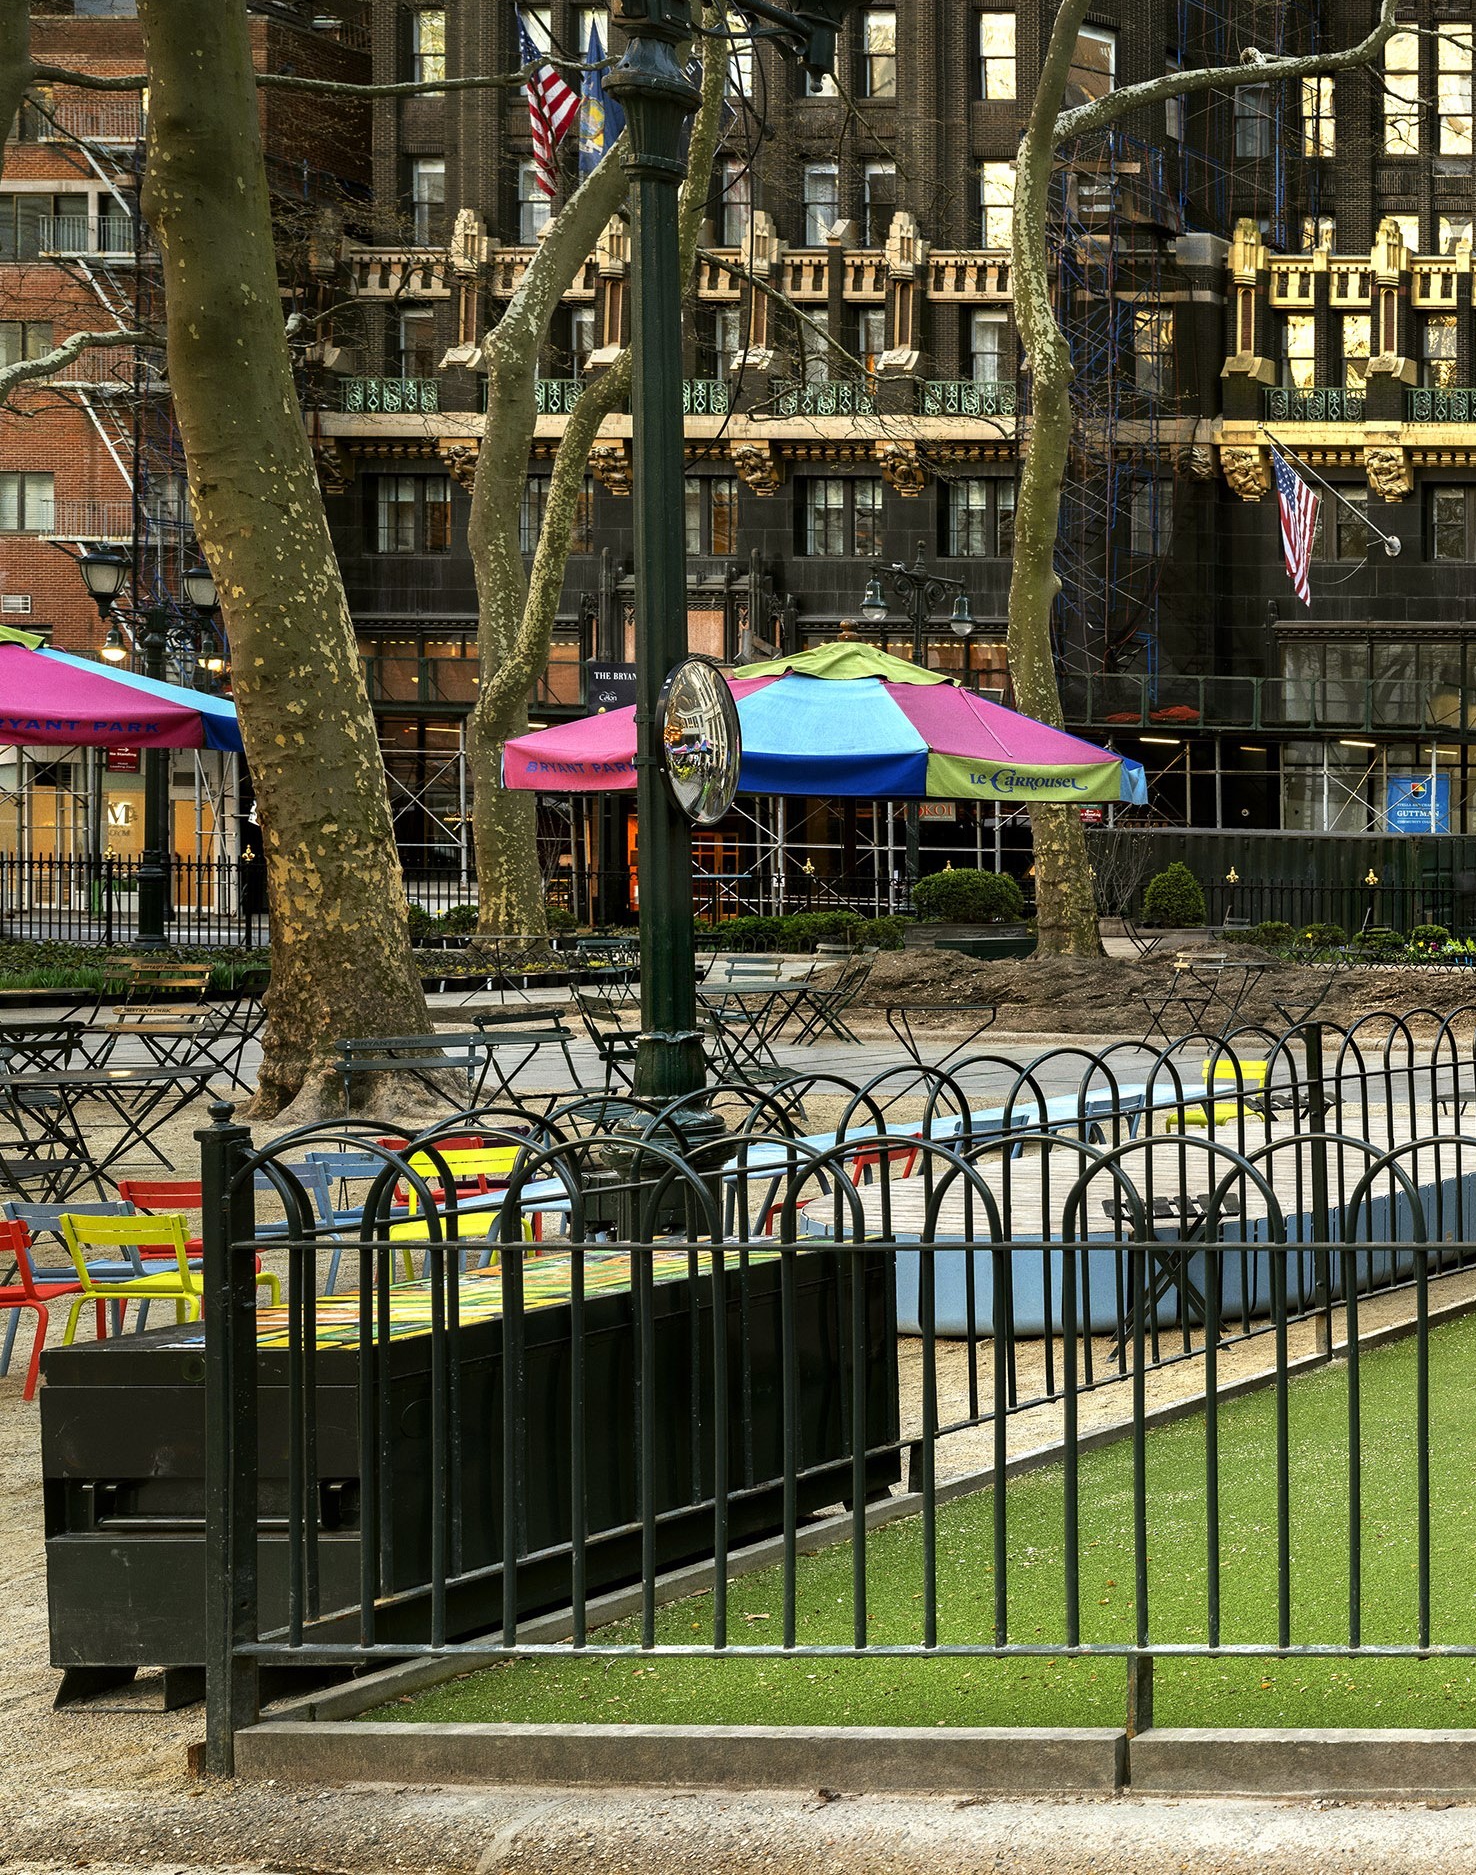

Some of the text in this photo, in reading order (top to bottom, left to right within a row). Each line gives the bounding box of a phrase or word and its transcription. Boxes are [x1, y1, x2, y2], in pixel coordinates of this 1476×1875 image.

[594, 671, 637, 680] THE BRYAN
[0, 718, 161, 733] YANT PARK
[527, 761, 585, 774] BRYANT
